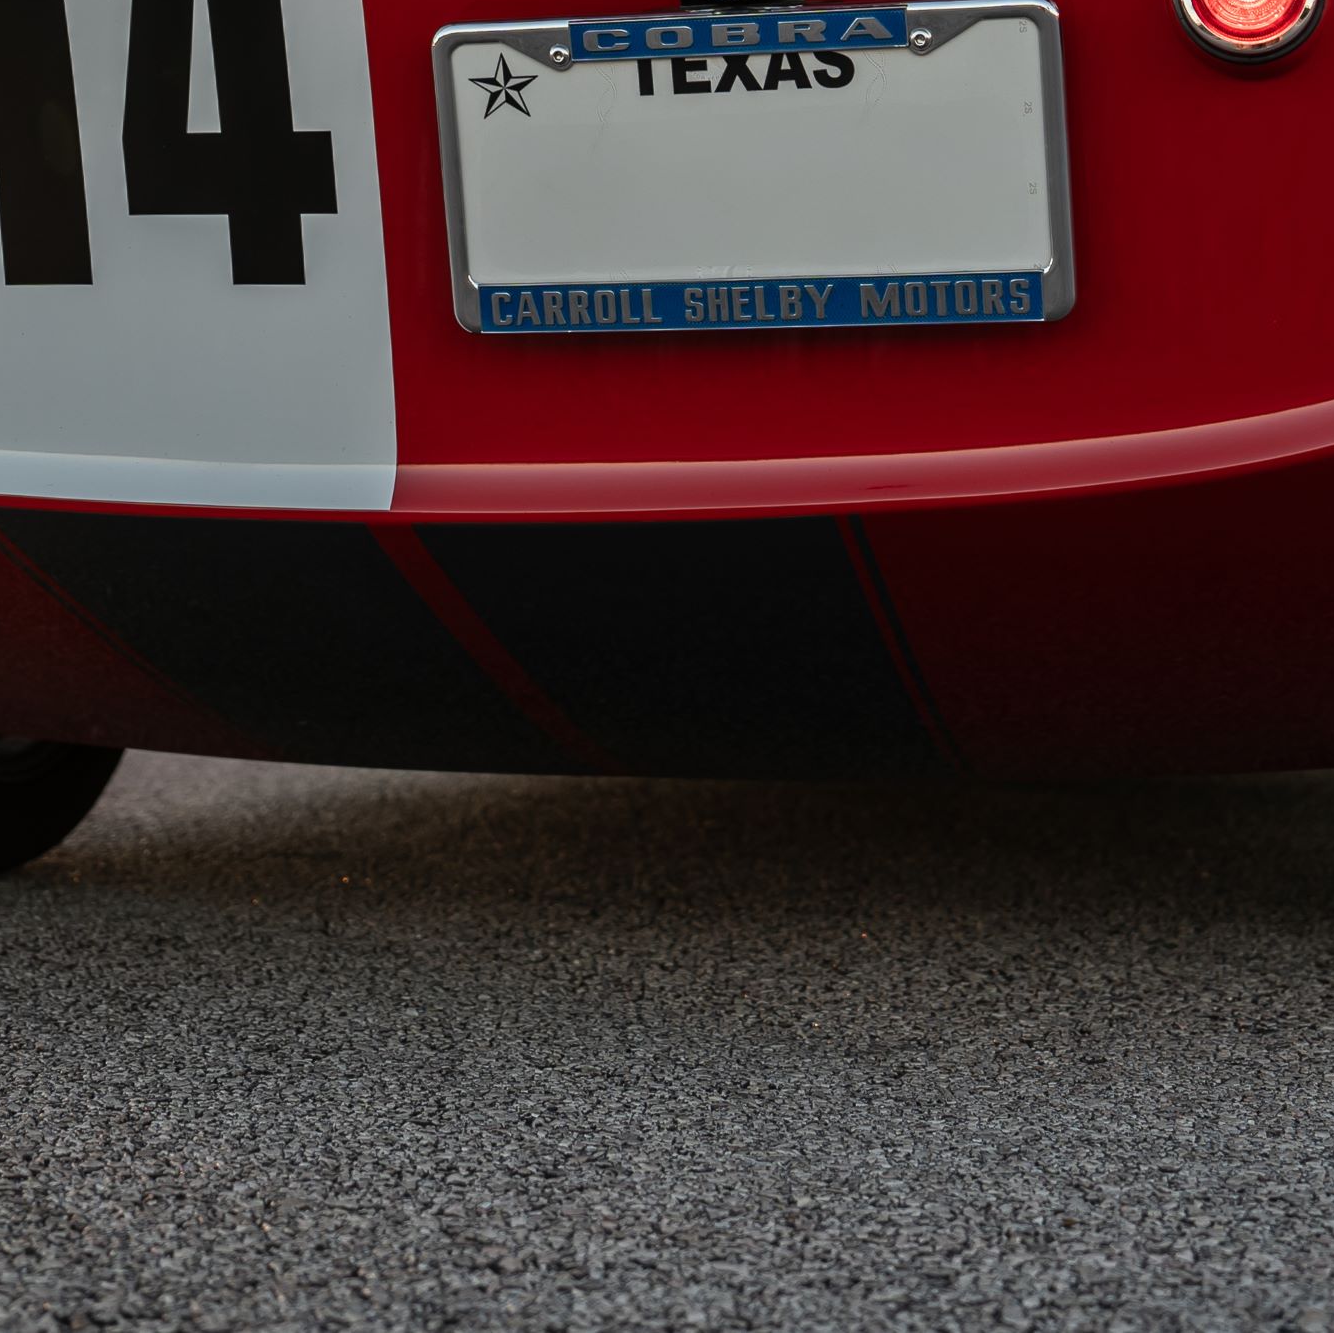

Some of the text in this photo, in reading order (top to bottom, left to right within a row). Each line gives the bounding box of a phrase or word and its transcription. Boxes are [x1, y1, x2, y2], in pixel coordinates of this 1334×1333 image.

[582, 17, 893, 52] COBRA
[490, 278, 1032, 327] CARROLL SHELBY MOTORS
